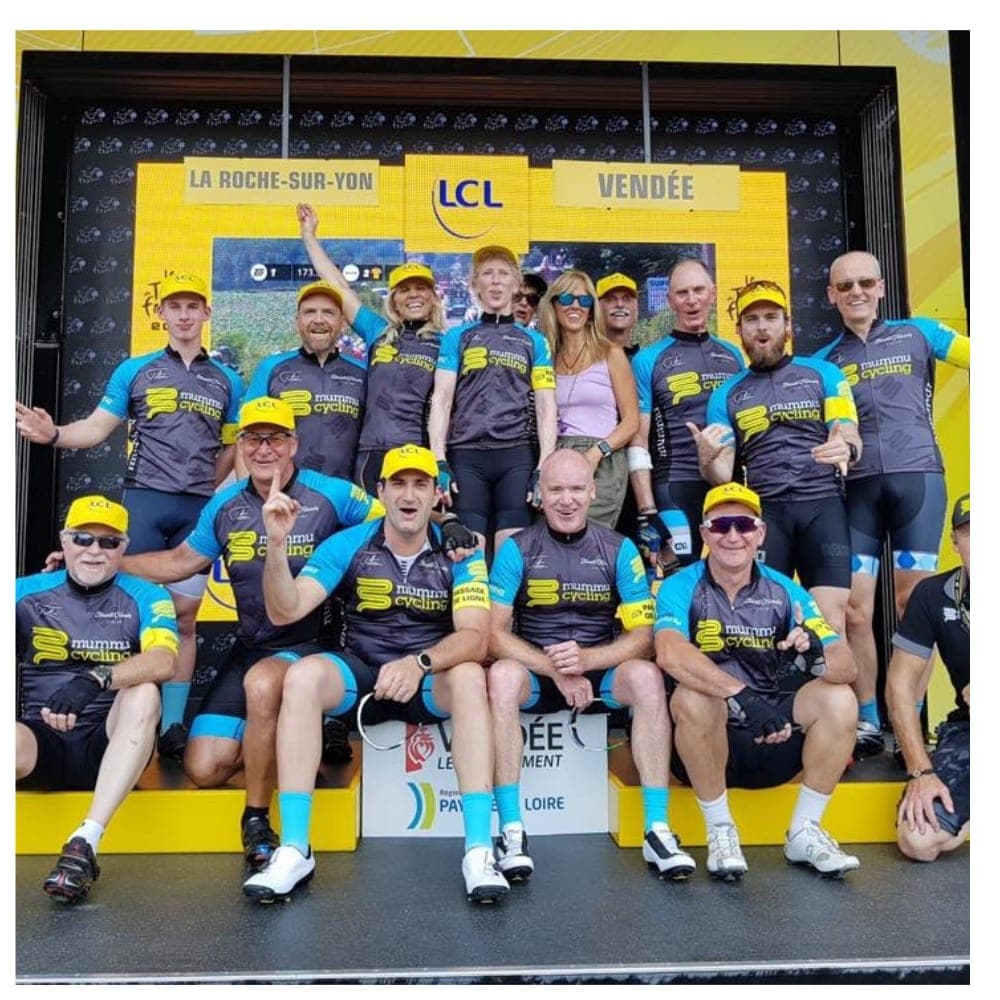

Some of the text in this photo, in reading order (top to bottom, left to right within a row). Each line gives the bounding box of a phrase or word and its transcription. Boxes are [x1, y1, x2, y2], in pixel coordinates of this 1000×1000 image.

[189, 169, 374, 191] LA ROCHE-SUR-YON
[597, 169, 695, 201] VENDÉE
[438, 179, 504, 209] LCL
[860, 353, 912, 371] mummu
[861, 363, 913, 380] cycling
[179, 400, 222, 420] cycling
[314, 401, 360, 419] cycling
[770, 408, 821, 422] cycling
[562, 582, 611, 593] mummu
[395, 594, 448, 611] cycling
[562, 591, 611, 603] cycling
[525, 796, 565, 811] LOIRE
